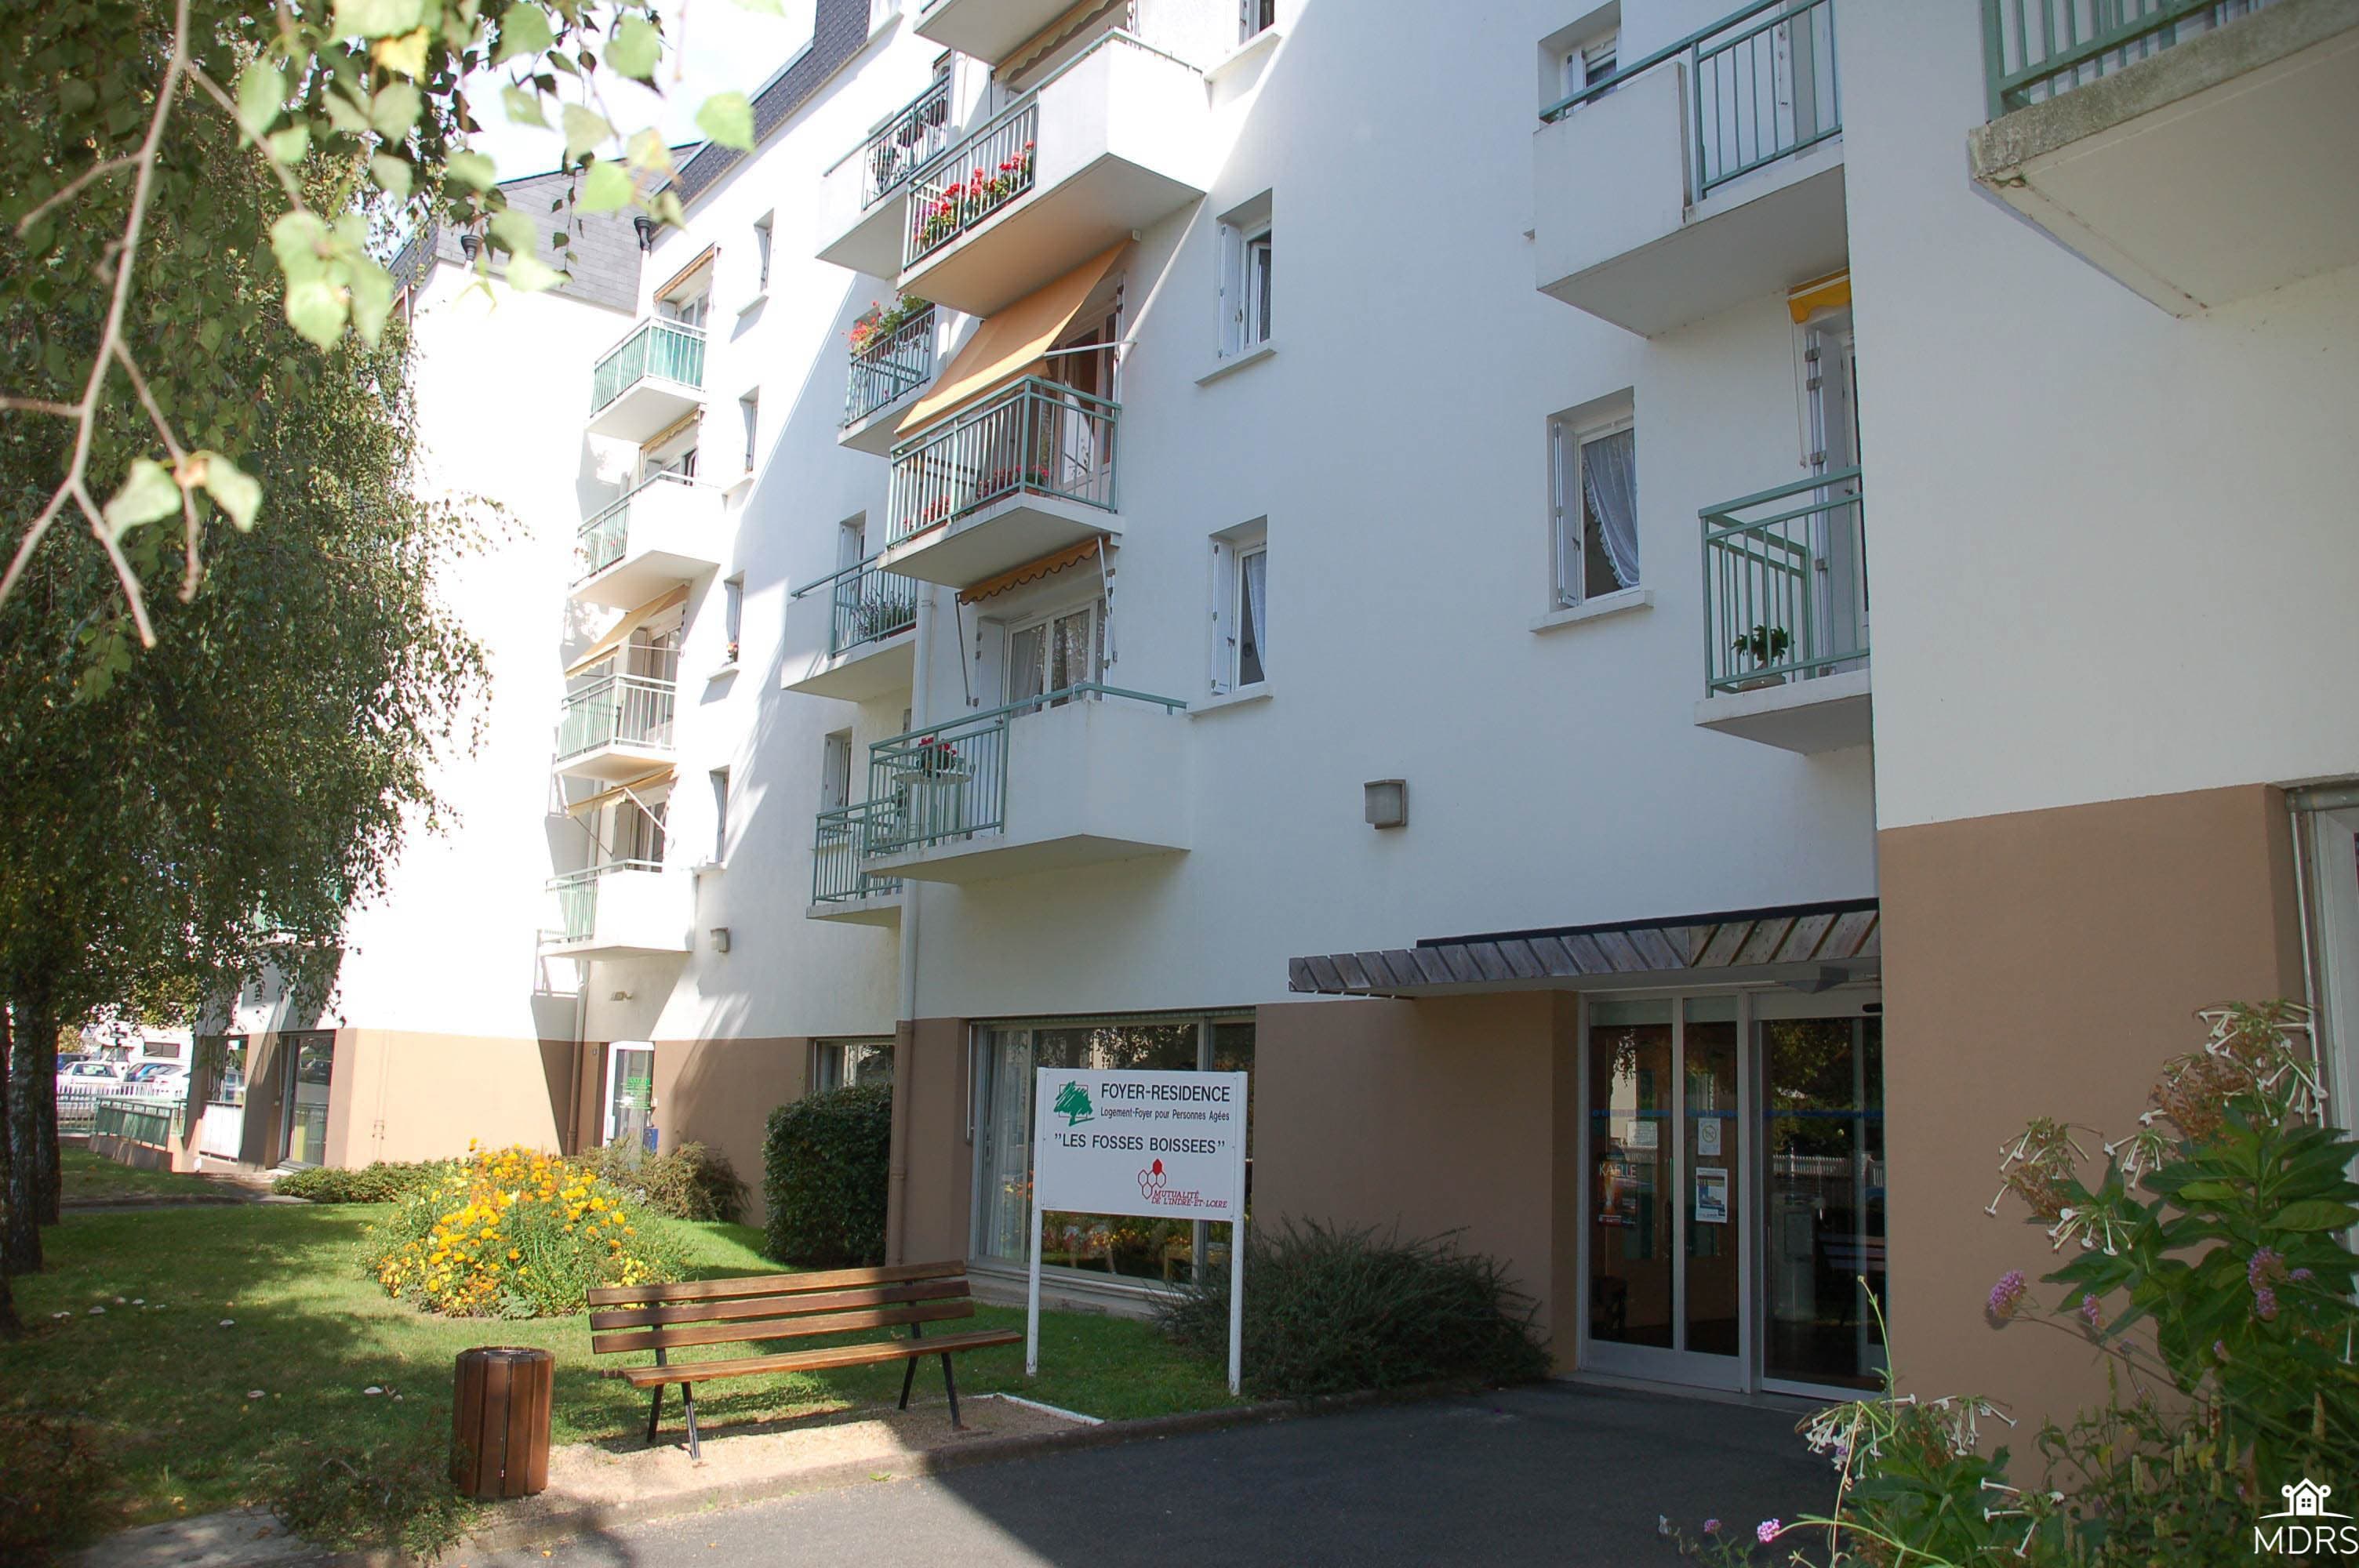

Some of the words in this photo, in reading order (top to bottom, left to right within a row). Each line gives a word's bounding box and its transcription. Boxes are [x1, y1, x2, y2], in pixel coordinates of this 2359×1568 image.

[1101, 1083, 1230, 1102] FOYER-RESIDENCE
[1100, 1106, 1152, 1122] Logement-Foyer
[1154, 1109, 1169, 1120] pour
[1172, 1109, 1205, 1120] Personnes
[1209, 1110, 1230, 1123] Agées
[1092, 1134, 1143, 1150] FOSSES
[1154, 1190, 1199, 1199] MUTUALITÉ
